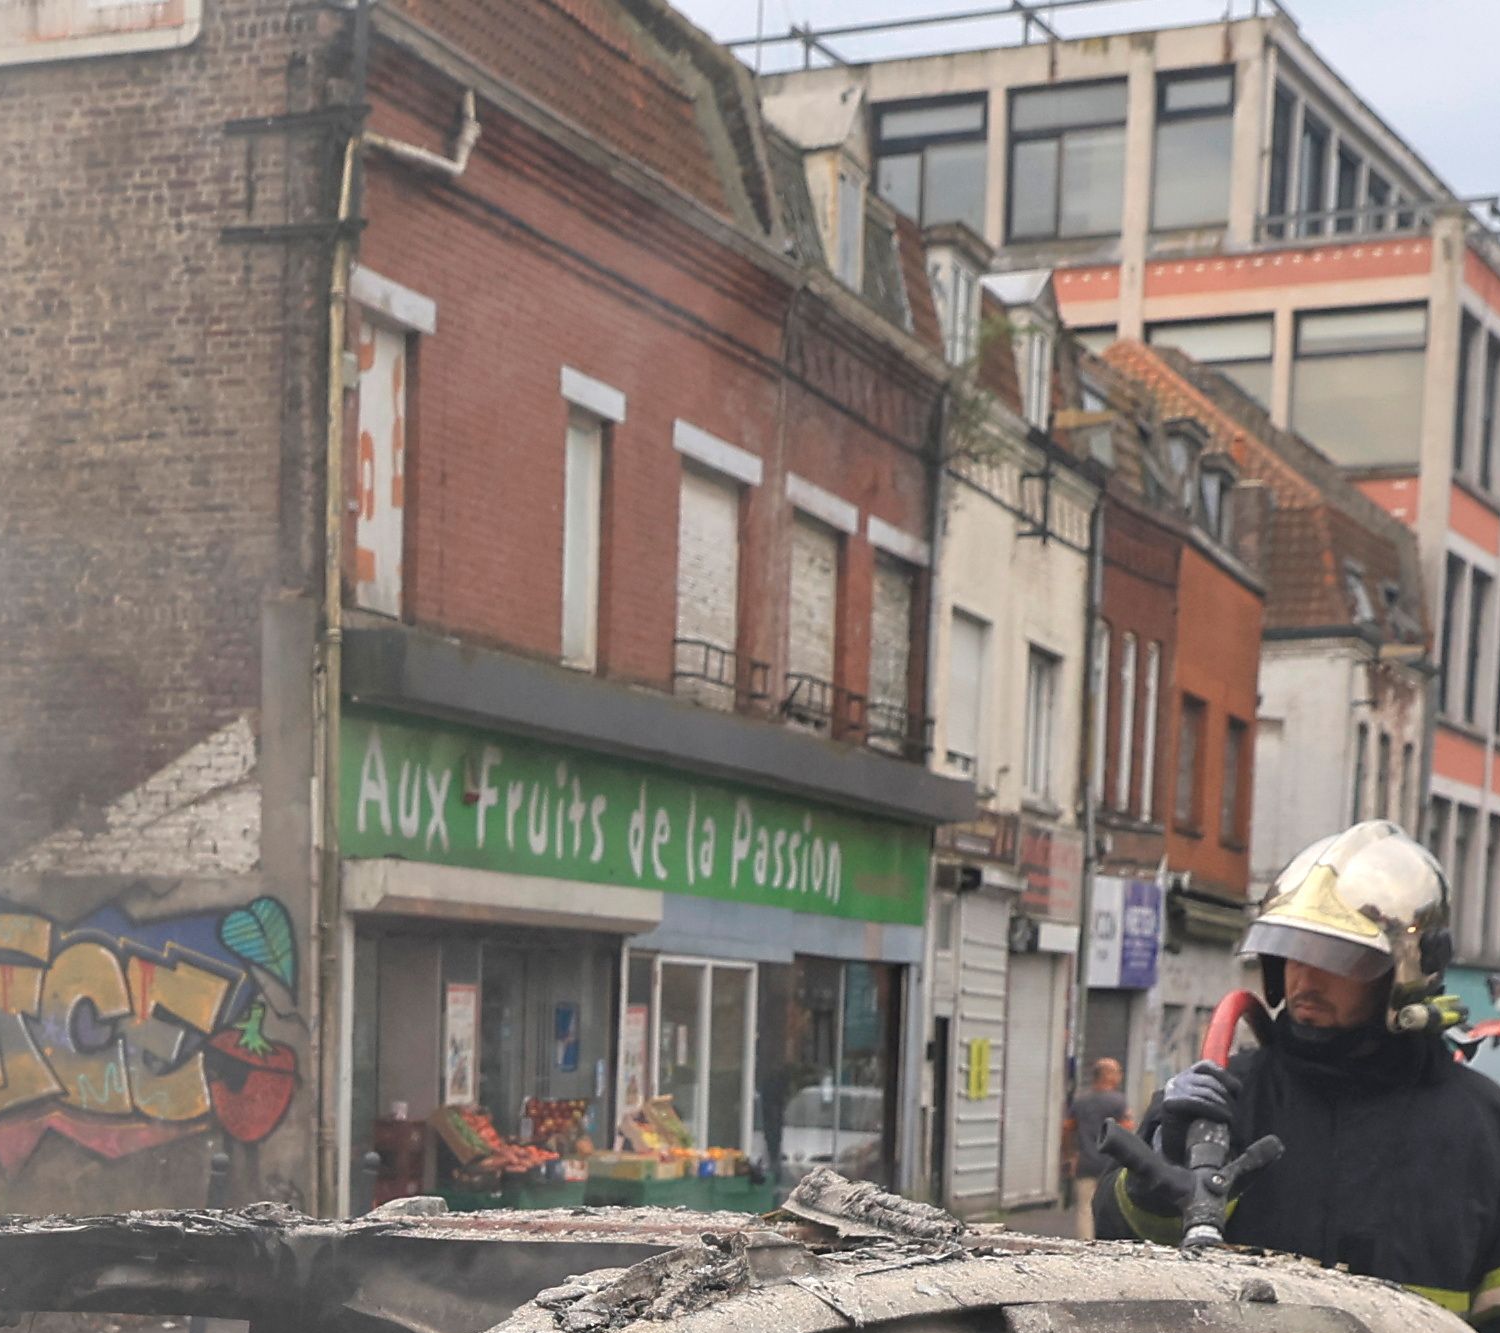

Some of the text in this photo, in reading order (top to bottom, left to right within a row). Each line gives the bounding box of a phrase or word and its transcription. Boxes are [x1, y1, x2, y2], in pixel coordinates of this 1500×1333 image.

[357, 727, 842, 906] Aux Fruits de la Passion
